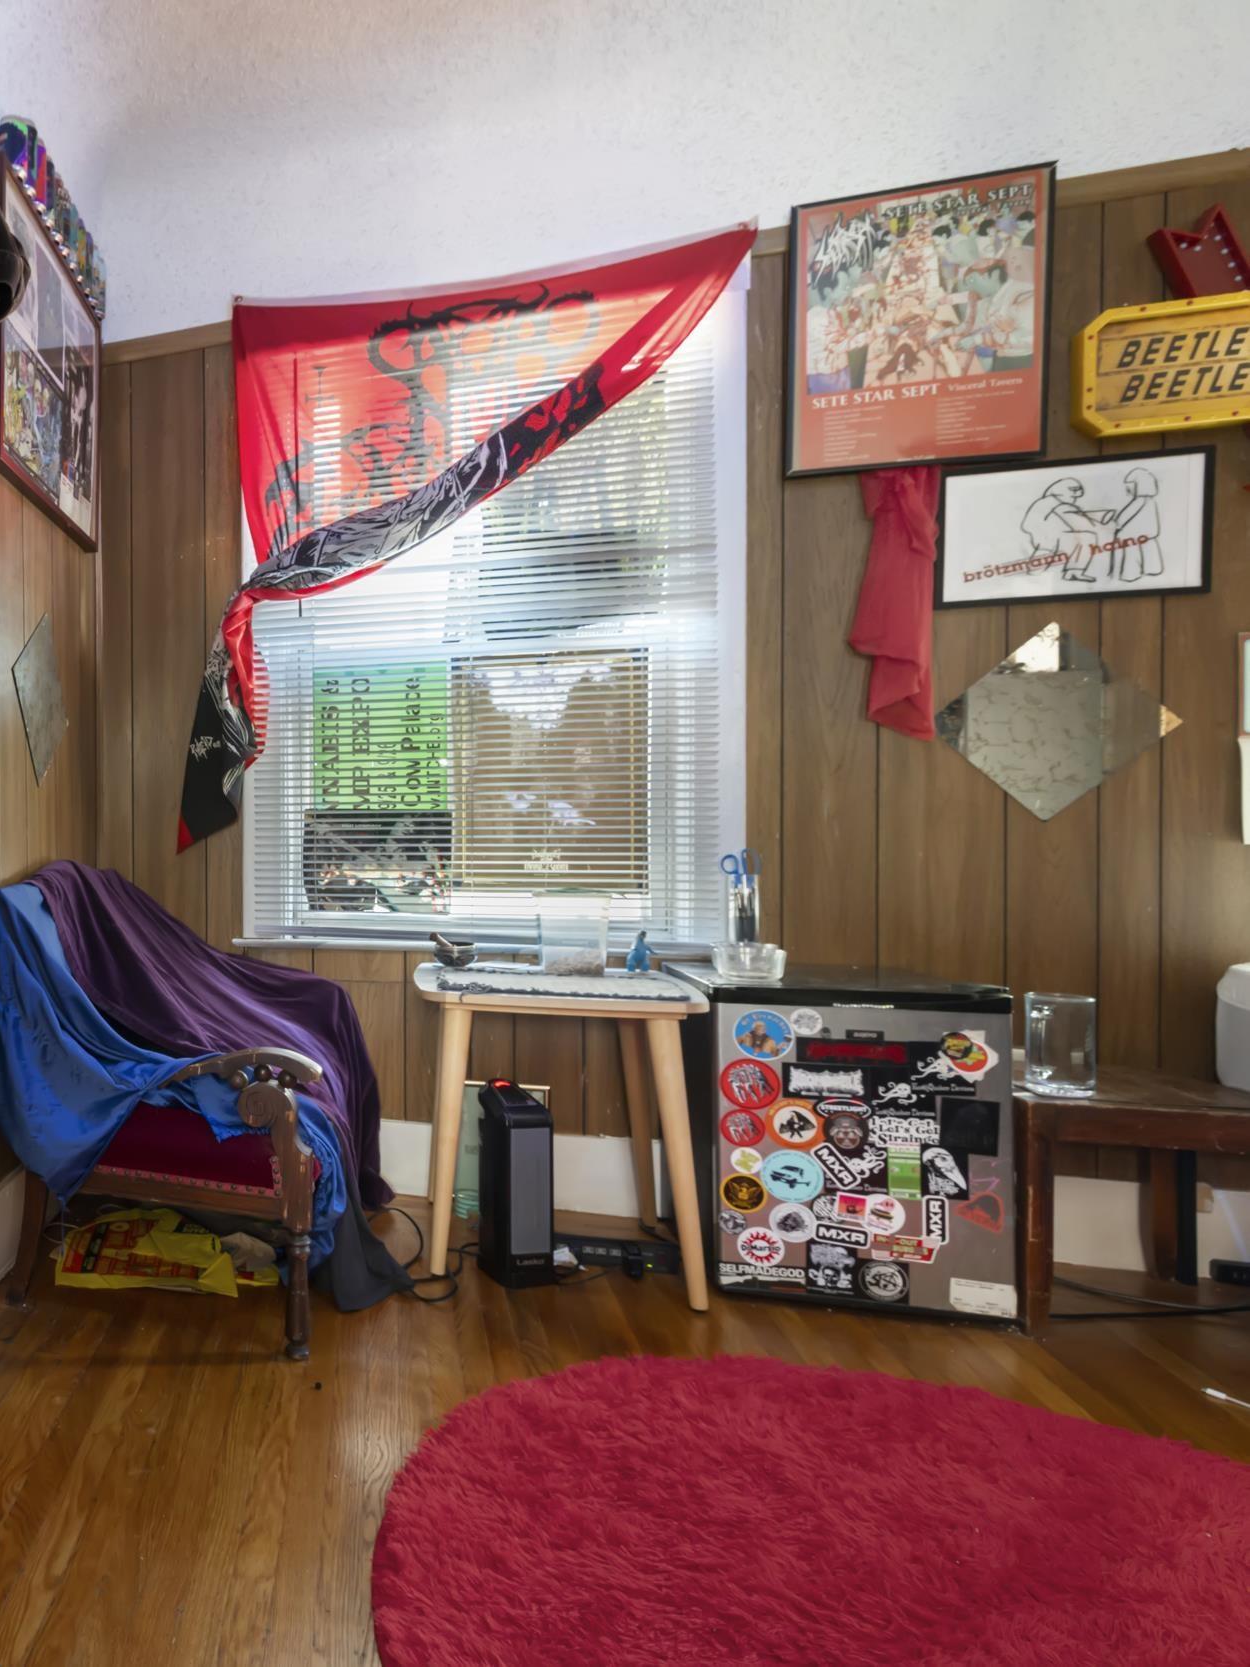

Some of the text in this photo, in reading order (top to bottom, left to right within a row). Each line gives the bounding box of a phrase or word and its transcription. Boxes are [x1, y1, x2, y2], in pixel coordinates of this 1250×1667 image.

[886, 183, 1032, 218] SETE STAR SEPT
[1117, 326, 1249, 369] BEETLE
[812, 395, 849, 410] SETE
[853, 390, 895, 406] STAR
[901, 382, 942, 399] SEPT
[1120, 362, 1250, 404] BEETLE
[962, 548, 1071, 584] brötzmann
[1089, 533, 1150, 558] haino
[400, 677, 422, 807] Cow Palace
[819, 1147, 852, 1186] MXR
[817, 1226, 866, 1244] MXR
[929, 1200, 943, 1240] MXR
[719, 1263, 805, 1278] SELFMADEGOD
